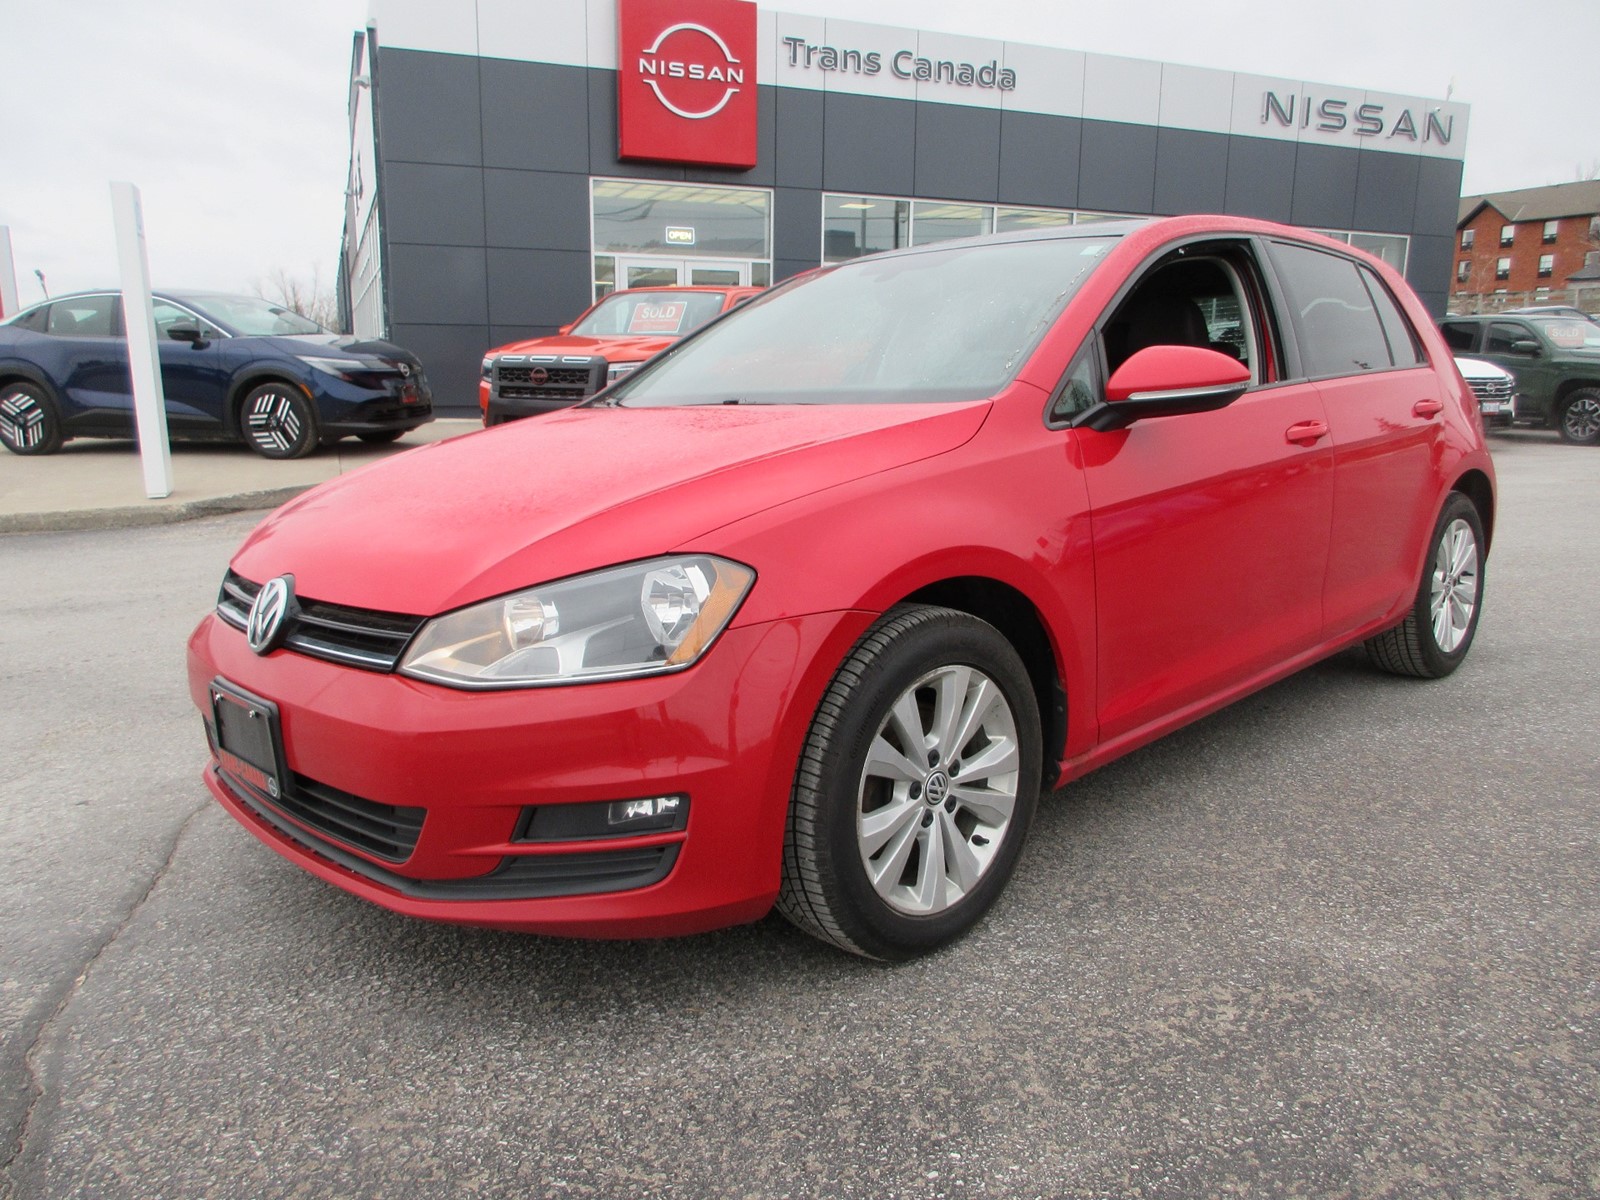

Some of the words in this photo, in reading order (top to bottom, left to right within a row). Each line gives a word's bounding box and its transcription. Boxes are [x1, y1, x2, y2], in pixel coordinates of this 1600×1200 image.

[638, 57, 745, 85] NISSAN
[783, 36, 882, 76] Trans
[891, 49, 1018, 91] Canada
[1260, 91, 1454, 145] NISSAN
[669, 231, 692, 240] OPEN
[641, 307, 676, 318] SOLD
[1552, 328, 1579, 337] SOLD
